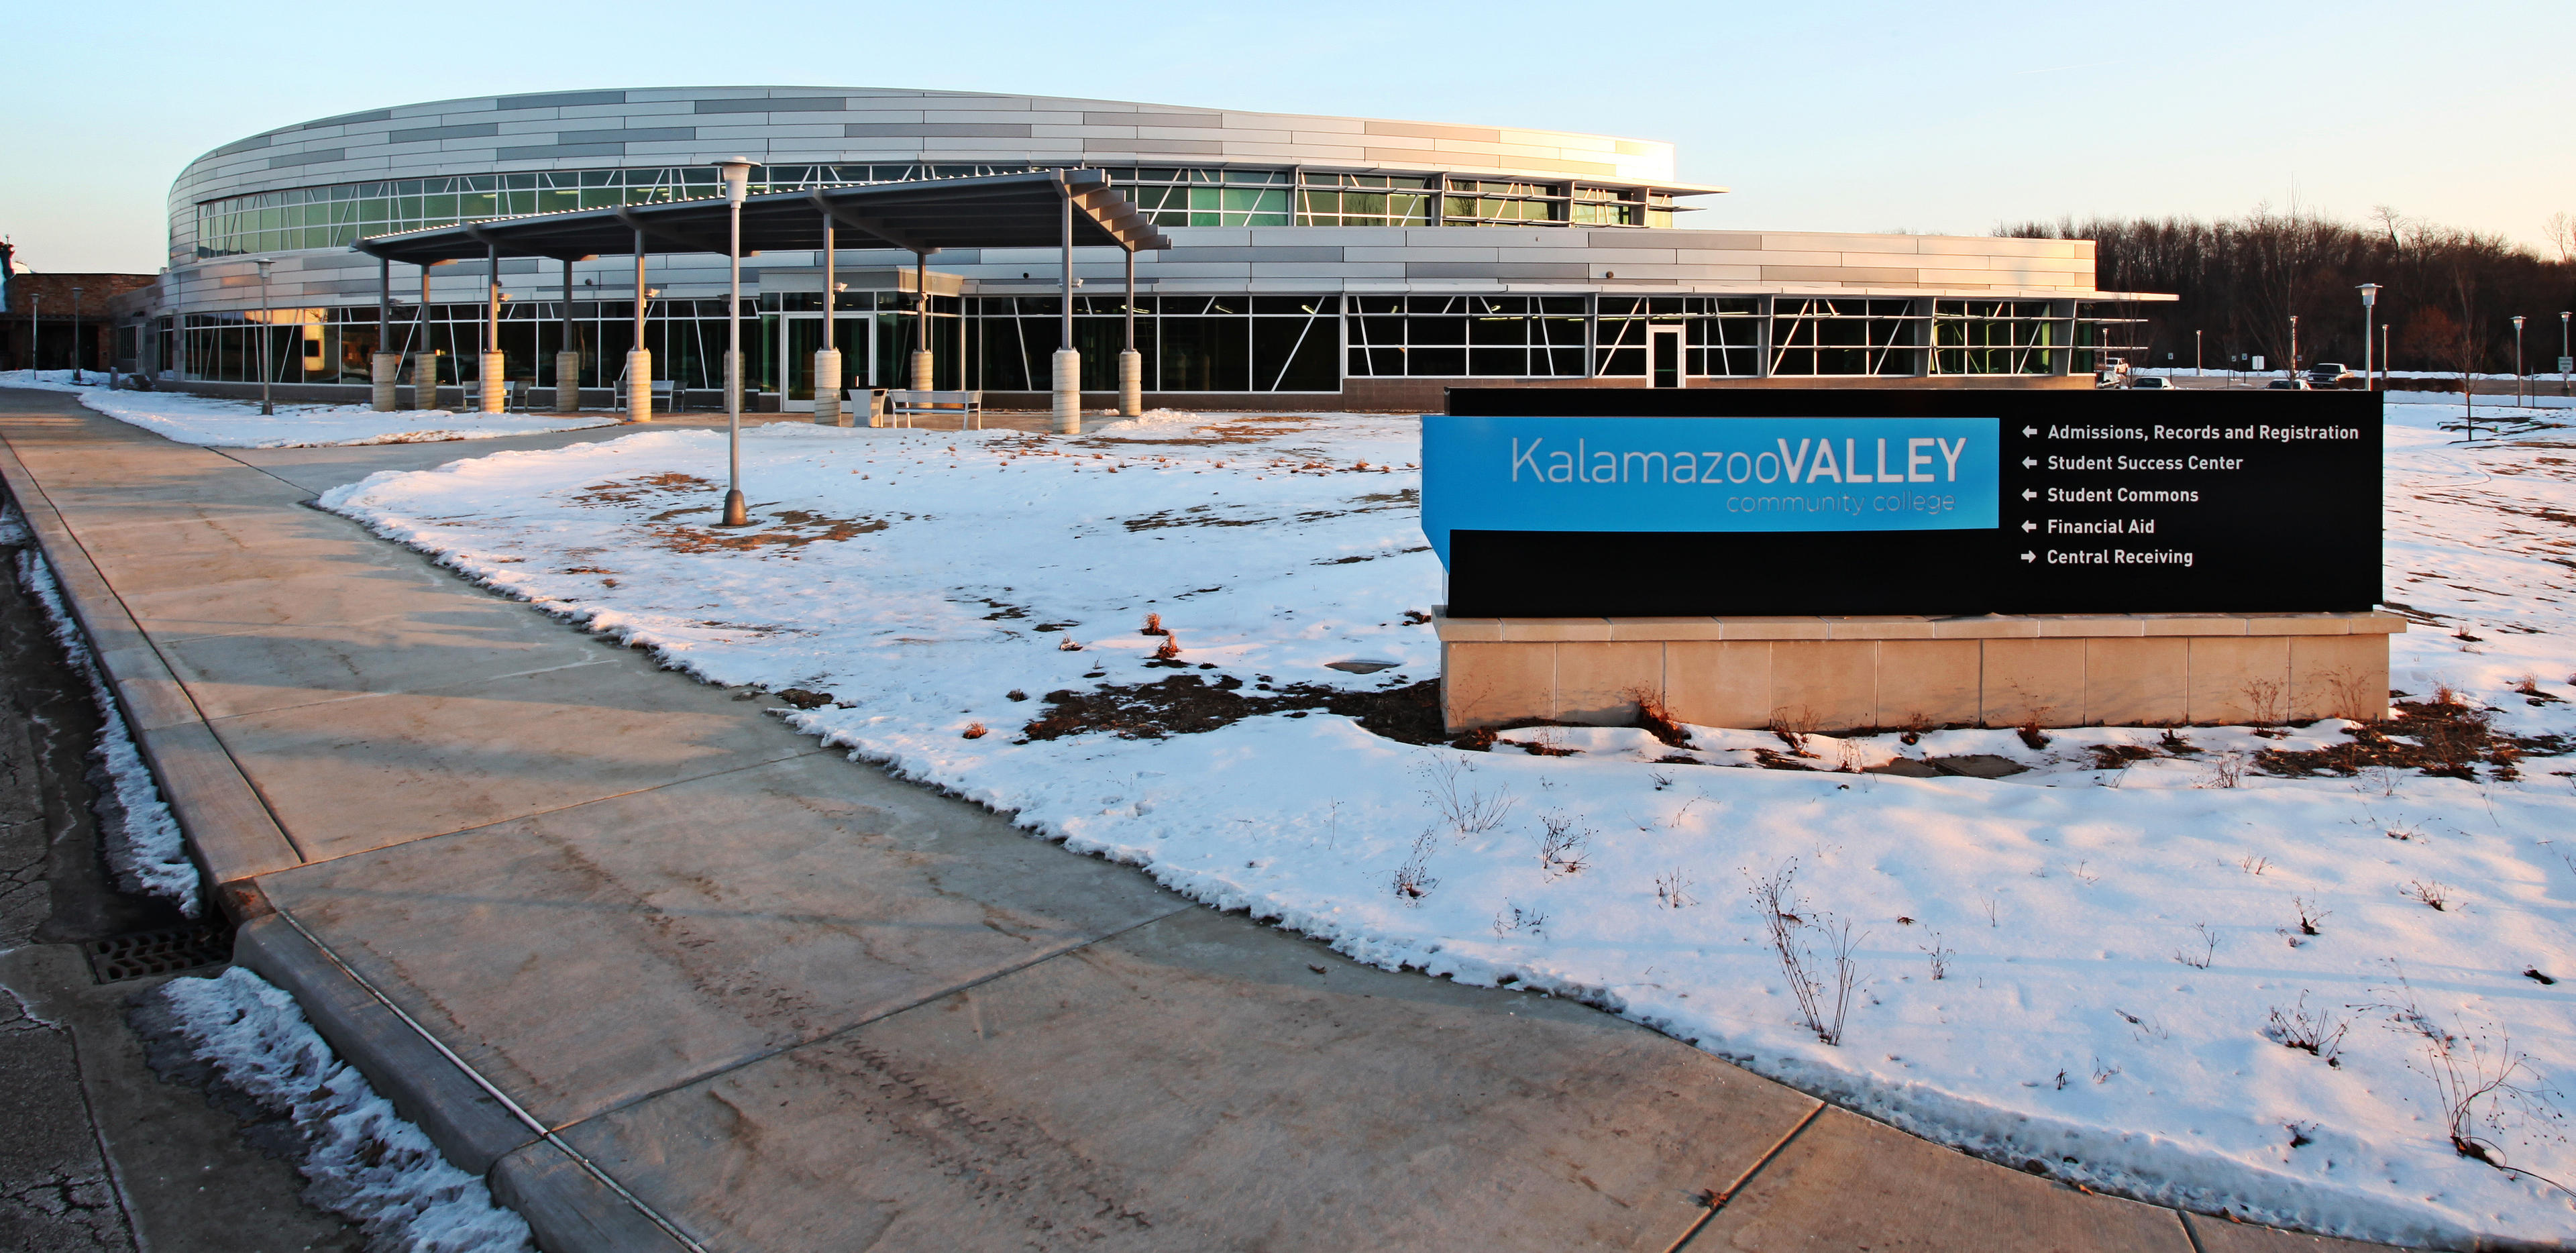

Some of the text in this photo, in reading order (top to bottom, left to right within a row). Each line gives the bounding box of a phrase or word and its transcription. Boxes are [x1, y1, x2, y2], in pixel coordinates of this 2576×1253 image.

[2047, 424, 2359, 443] Admissions, Records and Registration
[2047, 455, 2244, 470] Student Success Center
[2047, 487, 2199, 502] Student Commons
[1727, 490, 1956, 516] community college
[2047, 519, 2155, 534] Financial Aid
[2047, 549, 2193, 567] Central Receiving
